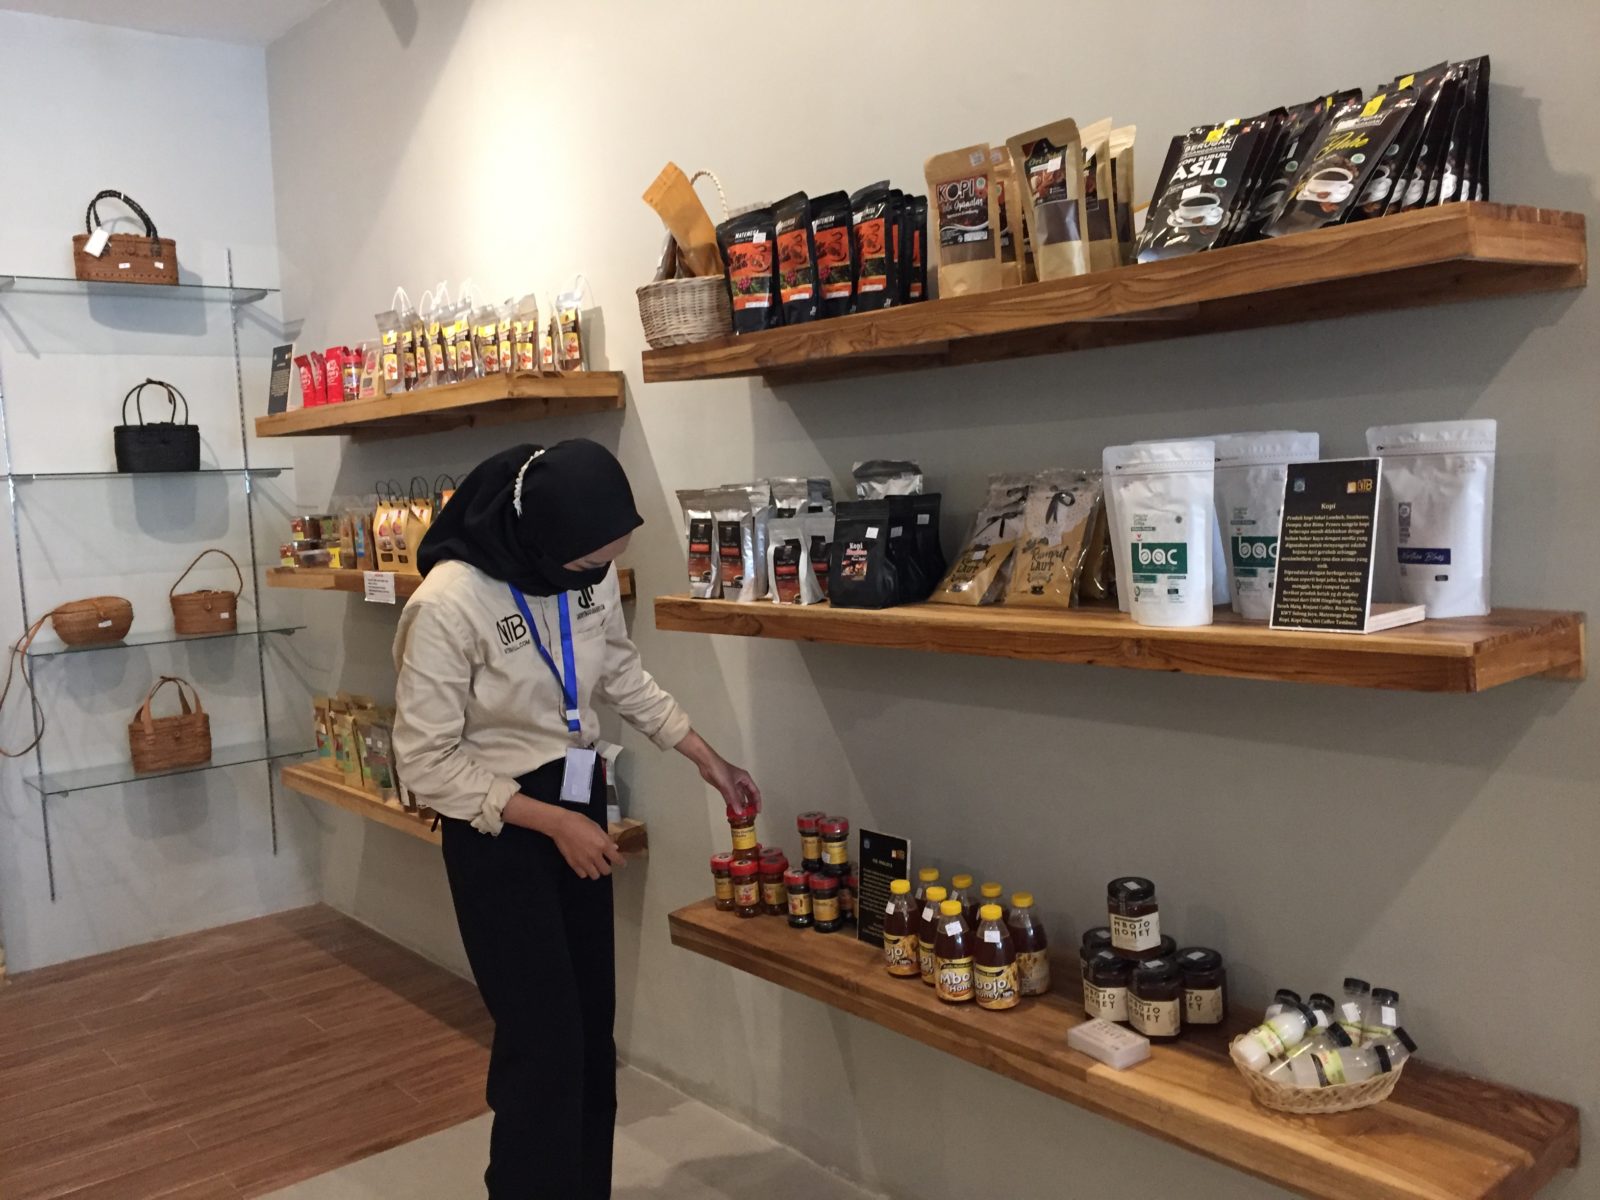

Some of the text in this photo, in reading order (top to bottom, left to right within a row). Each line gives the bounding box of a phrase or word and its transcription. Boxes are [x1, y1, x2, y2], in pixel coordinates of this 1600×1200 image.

[1169, 158, 1227, 184] ASLI
[936, 178, 975, 204] KOPI
[1320, 502, 1336, 511] Kopi
[1138, 541, 1177, 565] bac
[1030, 562, 1054, 572] LAUT
[496, 613, 527, 646] NTB
[1114, 920, 1151, 931] MBOJO
[1114, 928, 1151, 939] HONEY
[940, 973, 971, 986] Mbo
[976, 979, 1008, 996] bojo
